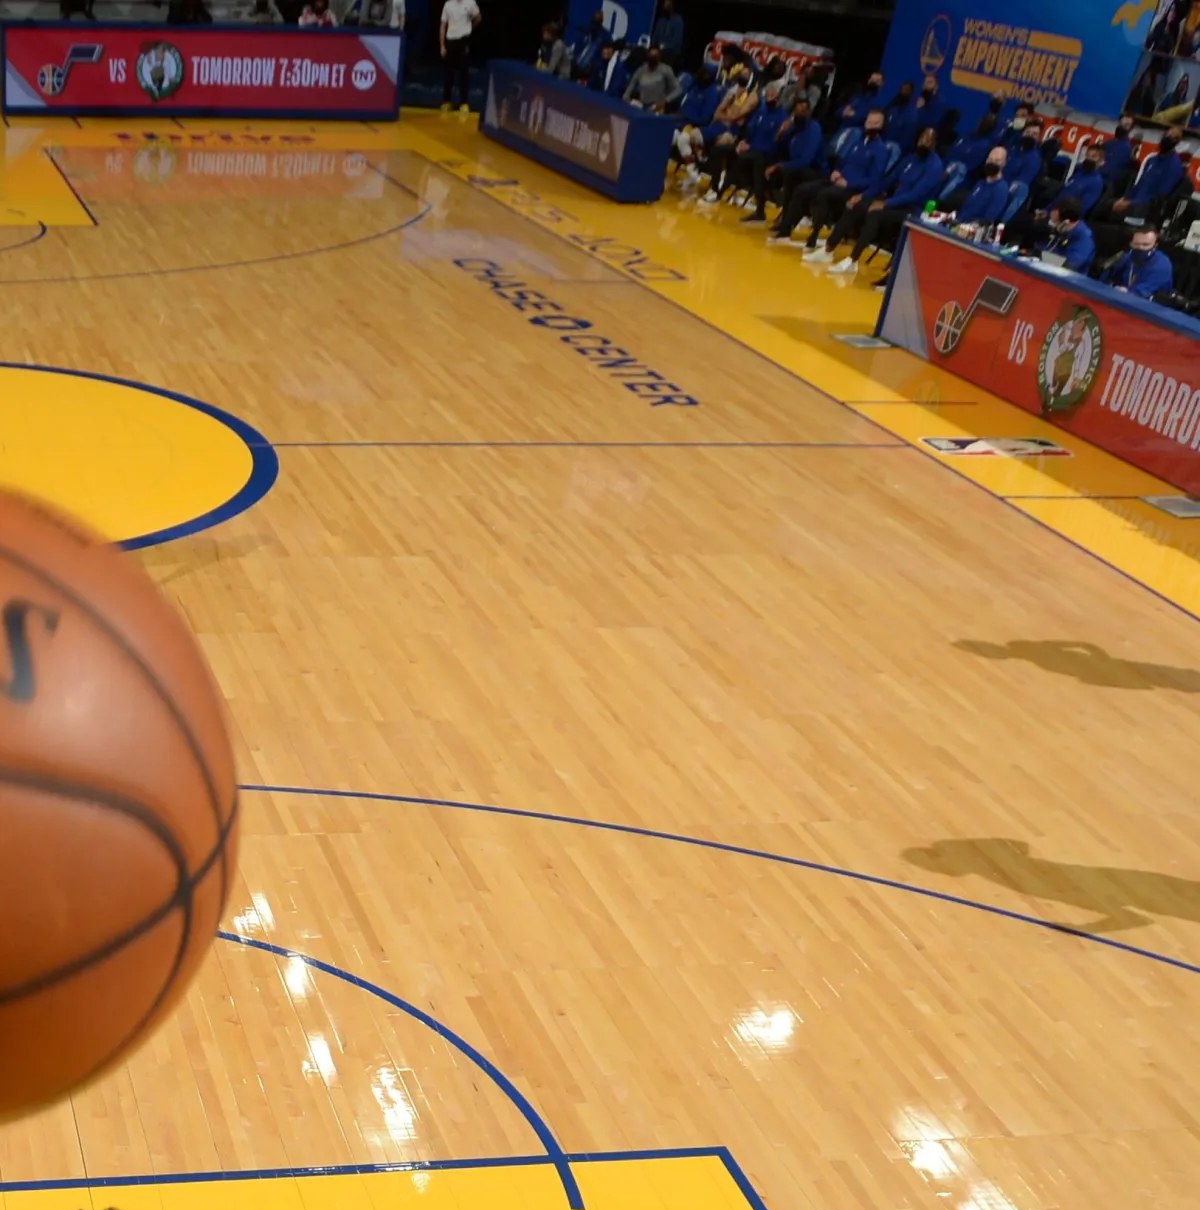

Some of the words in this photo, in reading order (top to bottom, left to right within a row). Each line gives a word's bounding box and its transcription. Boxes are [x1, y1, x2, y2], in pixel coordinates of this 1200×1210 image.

[964, 17, 1030, 45] WOMEN'S
[109, 58, 126, 83] VS
[191, 56, 275, 87] TOMORROW
[331, 63, 346, 88] ET
[953, 36, 1080, 93] EMPOWERMENT
[1007, 319, 1034, 365] VS
[560, 334, 700, 406] CENTER
